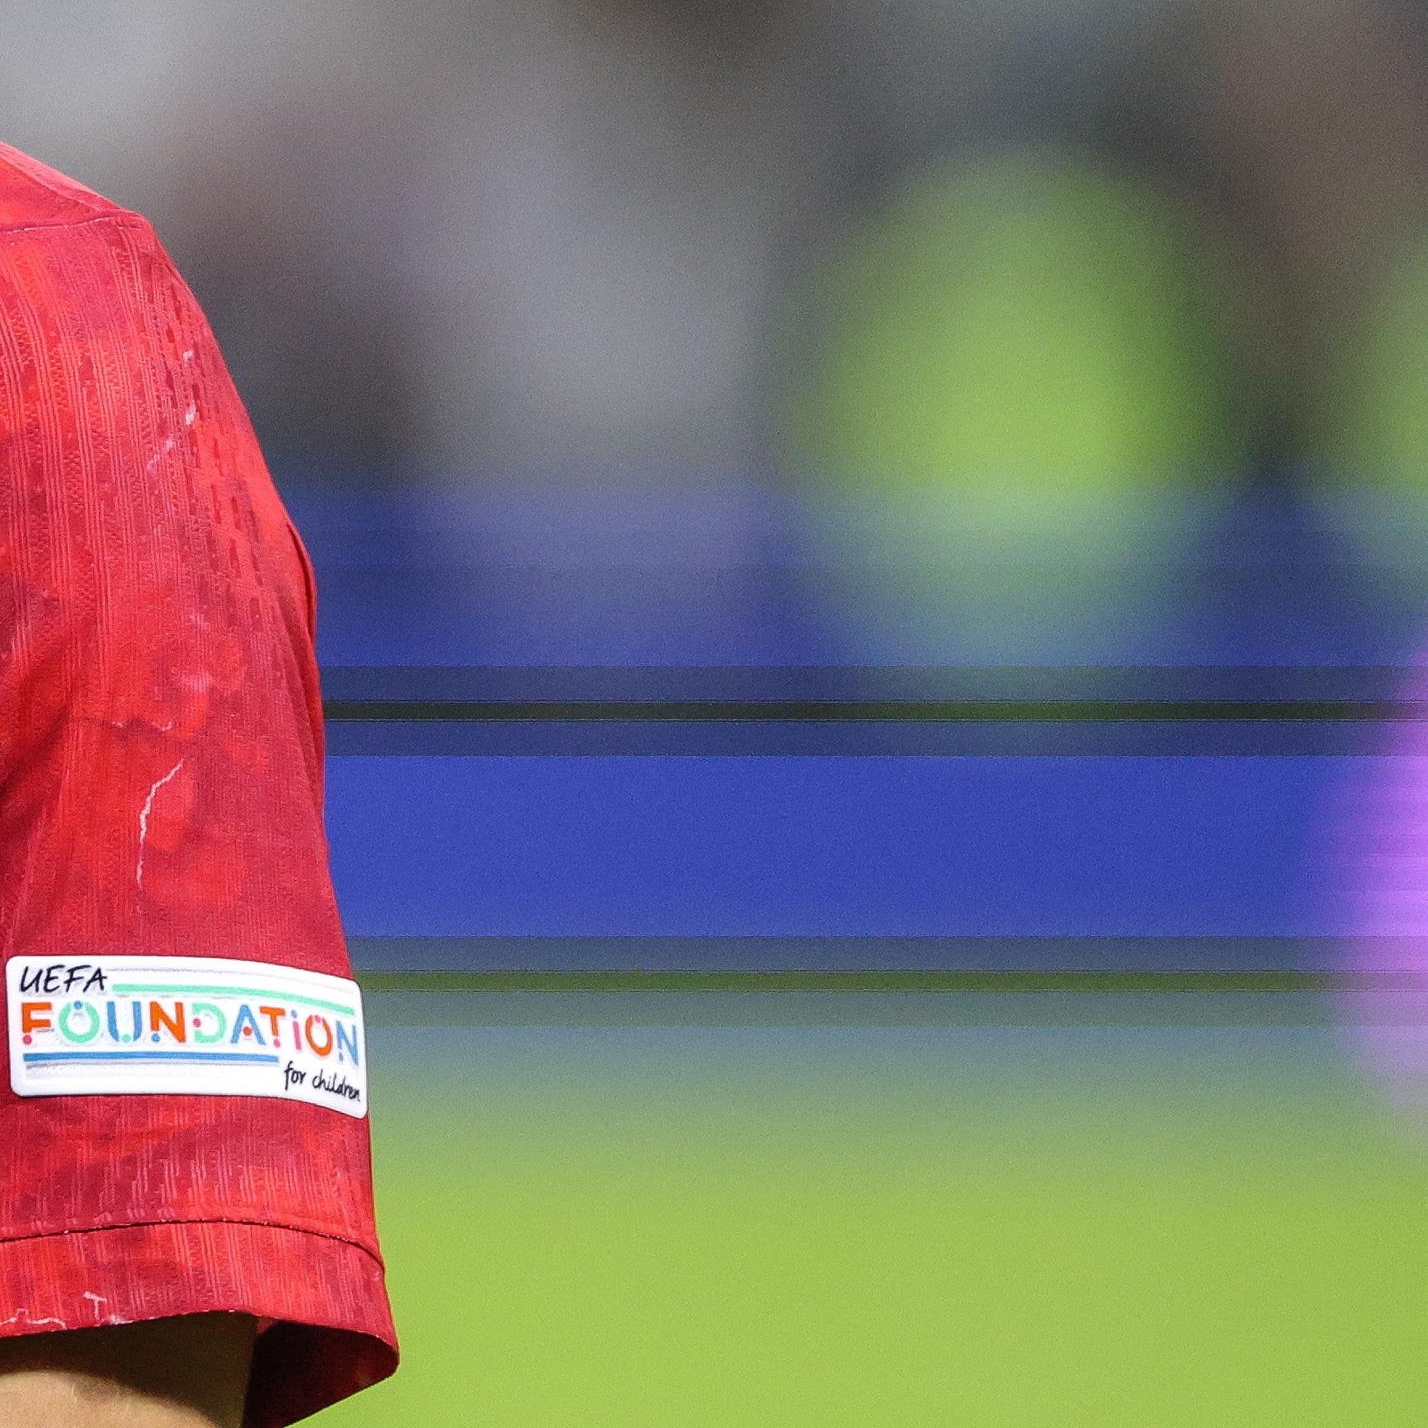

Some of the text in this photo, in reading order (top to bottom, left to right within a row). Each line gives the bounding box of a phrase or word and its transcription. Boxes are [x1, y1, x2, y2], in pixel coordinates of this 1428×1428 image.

[19, 964, 108, 994] UEFA
[284, 1060, 361, 1102] for children
